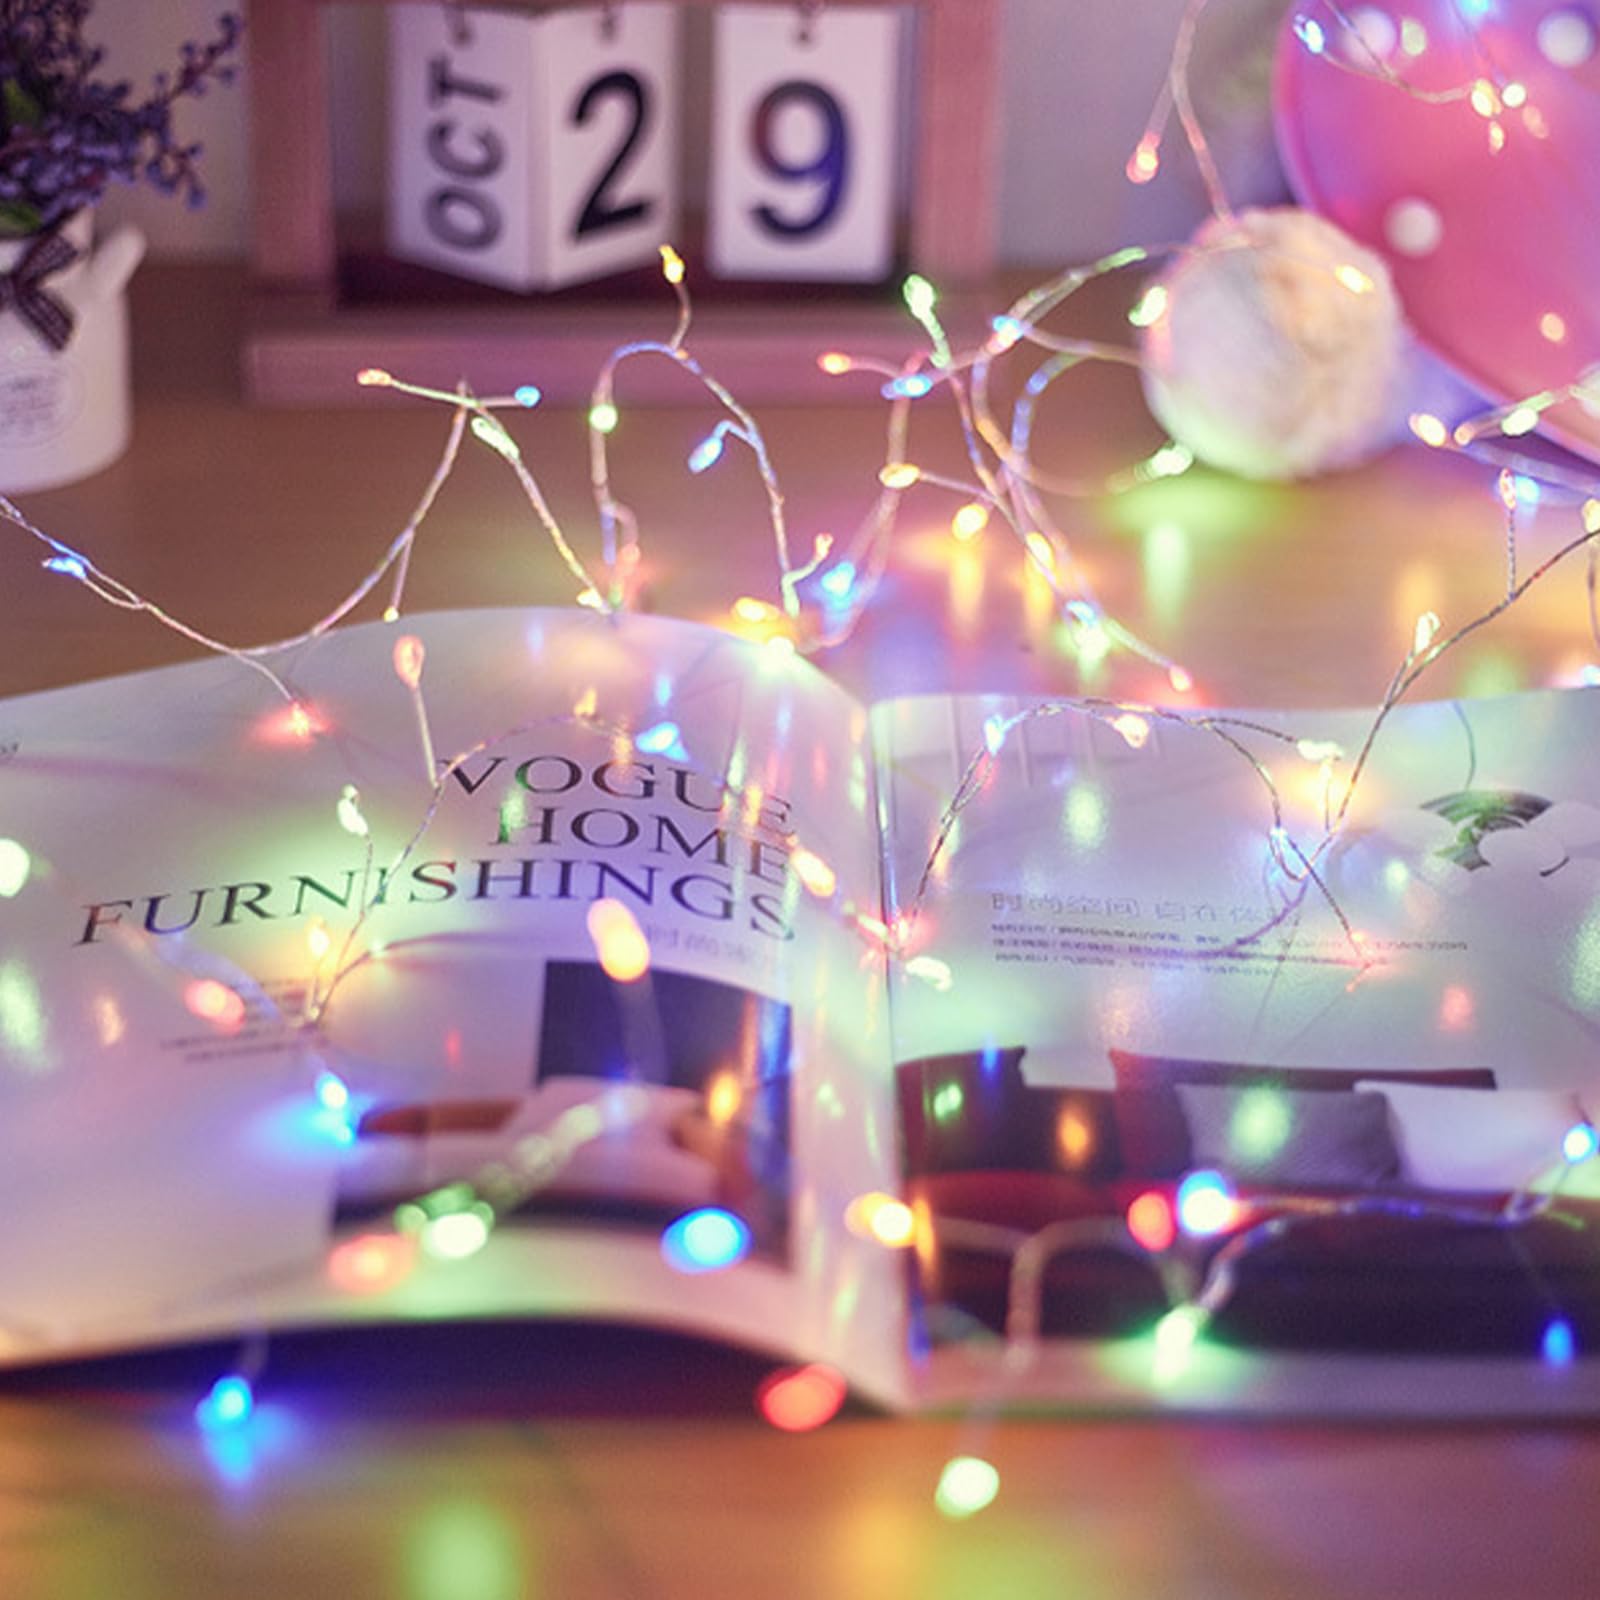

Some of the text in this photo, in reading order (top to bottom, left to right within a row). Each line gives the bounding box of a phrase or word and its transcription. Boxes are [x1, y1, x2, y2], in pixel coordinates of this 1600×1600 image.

[428, 58, 506, 250] OCT
[438, 754, 792, 838] VOGUE
[490, 806, 792, 888] HOME
[74, 860, 795, 946] FURNISHINGS
